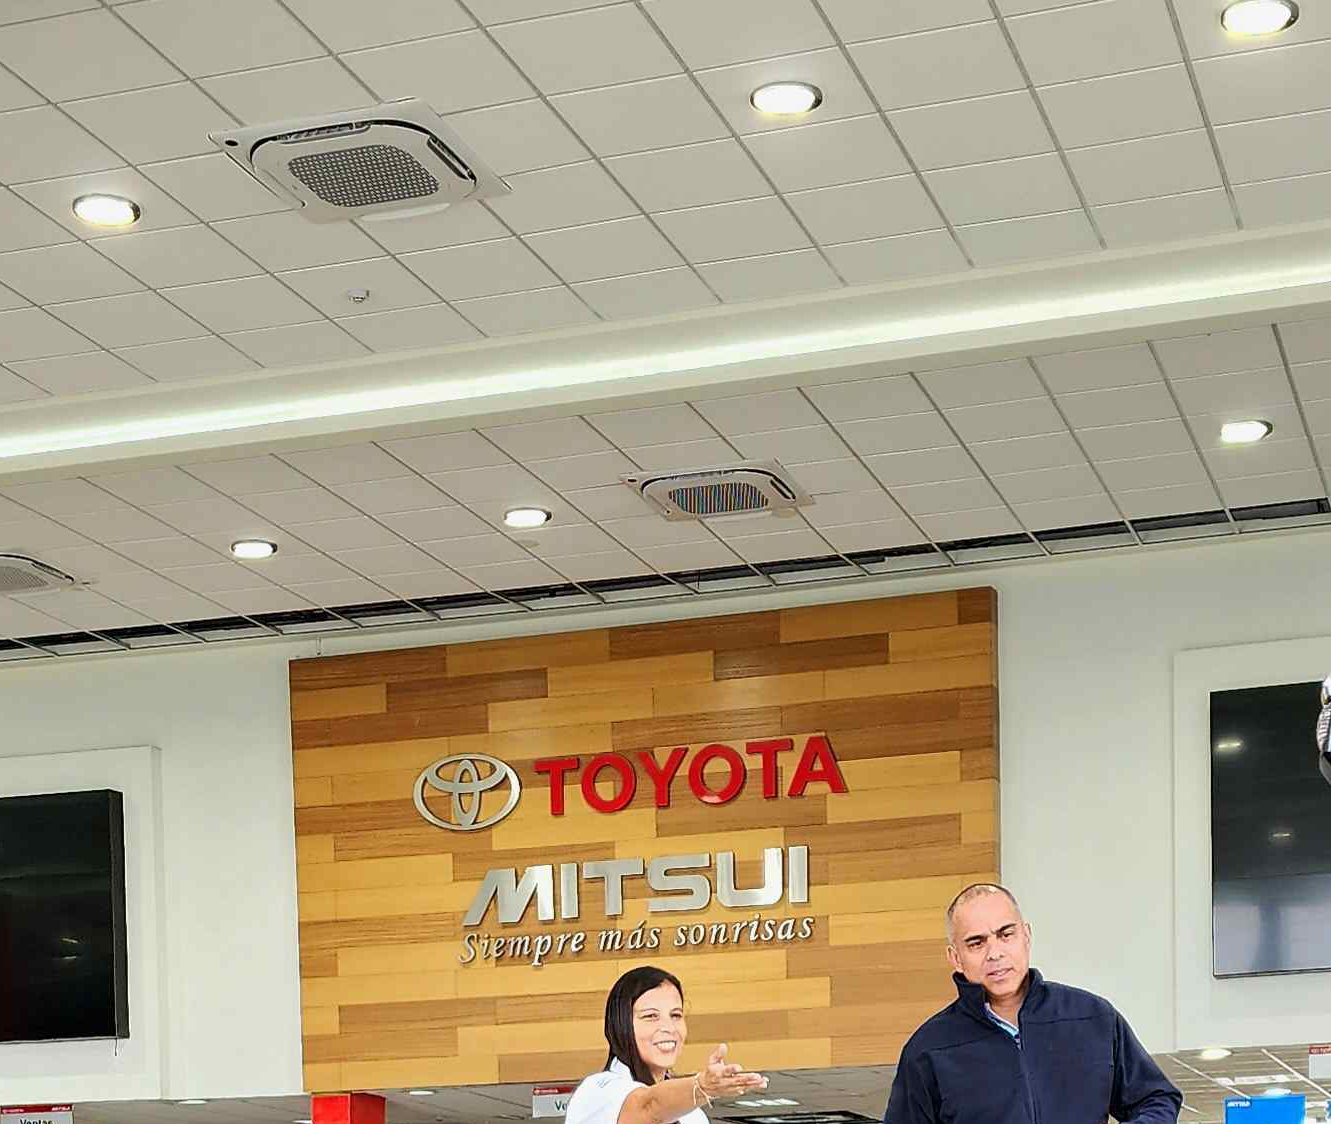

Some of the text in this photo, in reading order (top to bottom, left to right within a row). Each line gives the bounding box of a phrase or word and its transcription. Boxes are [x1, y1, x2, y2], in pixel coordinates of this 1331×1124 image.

[533, 735, 849, 817] TOYOTA
[462, 845, 810, 927] MITSUI
[458, 914, 815, 967] Siempre más sonrisas
